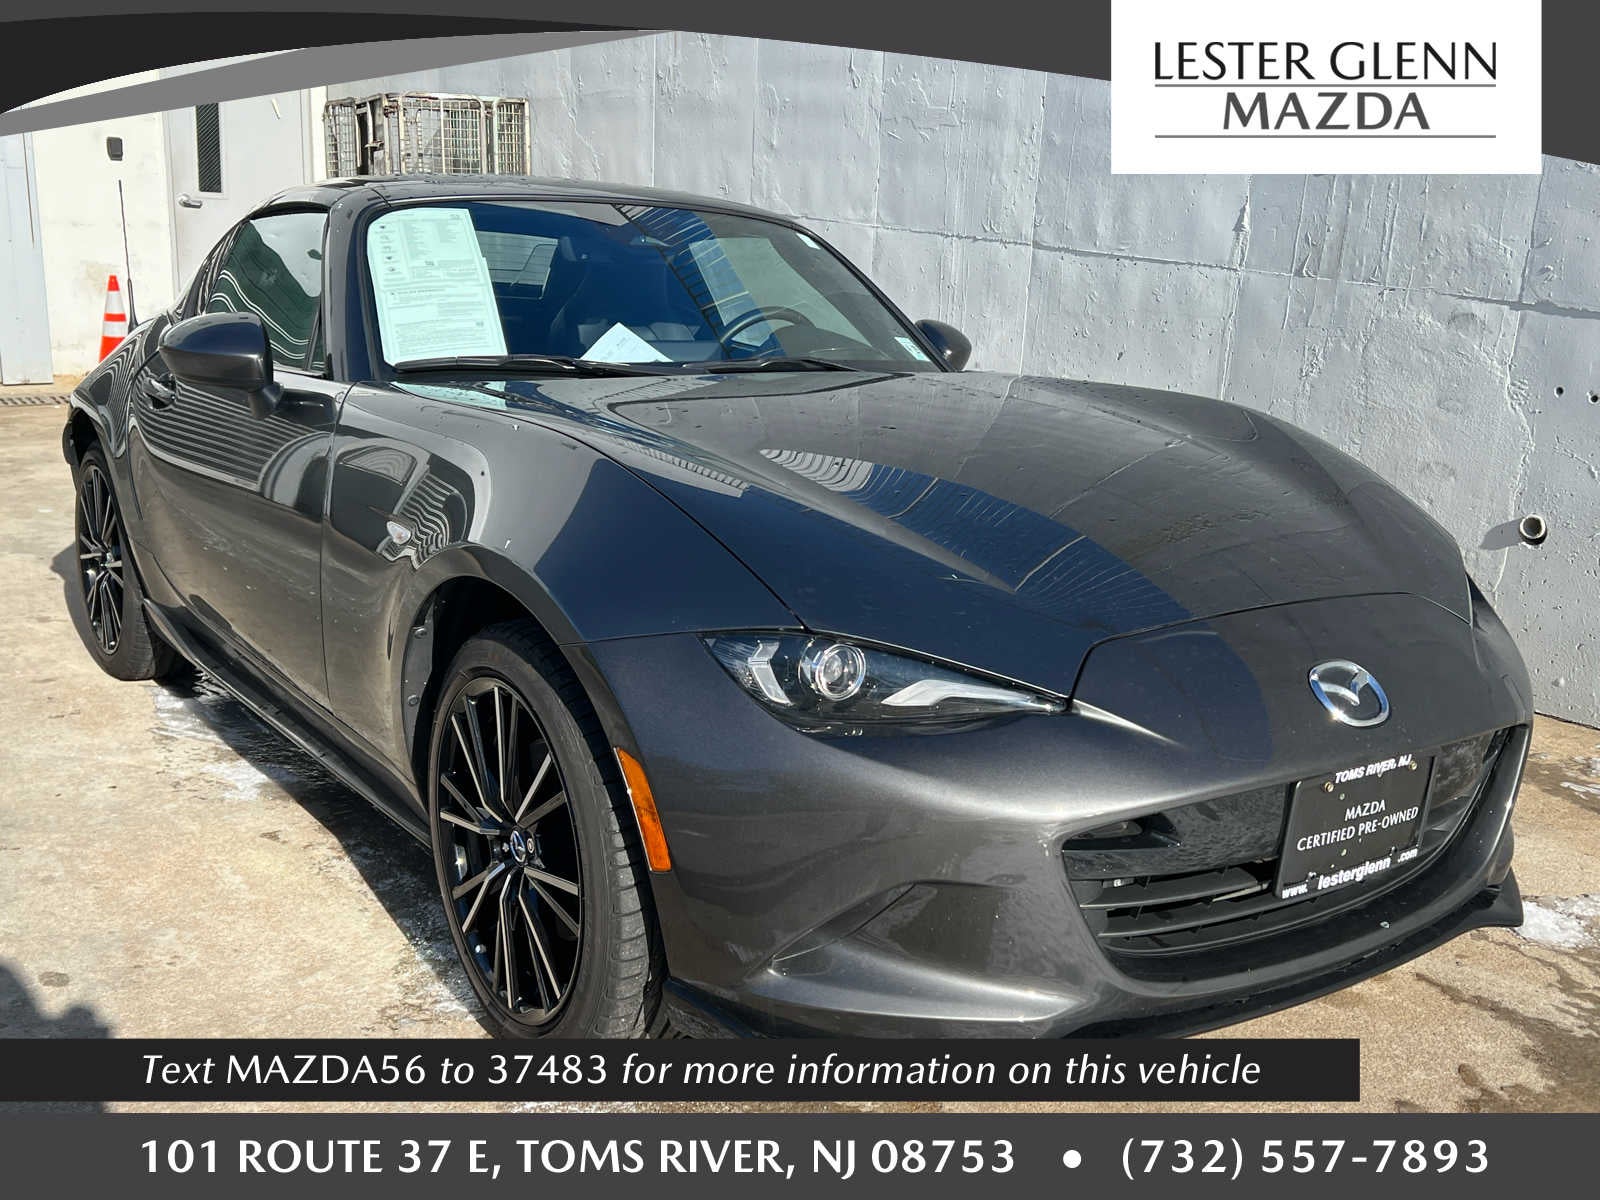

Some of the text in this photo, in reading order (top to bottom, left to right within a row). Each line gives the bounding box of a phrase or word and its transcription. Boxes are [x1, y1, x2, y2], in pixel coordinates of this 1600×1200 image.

[1335, 754, 1412, 784] TOMS RIVER, NJ
[1344, 799, 1386, 821] MAZDA
[1296, 806, 1419, 851] CERTIFIED PRE-OWNED
